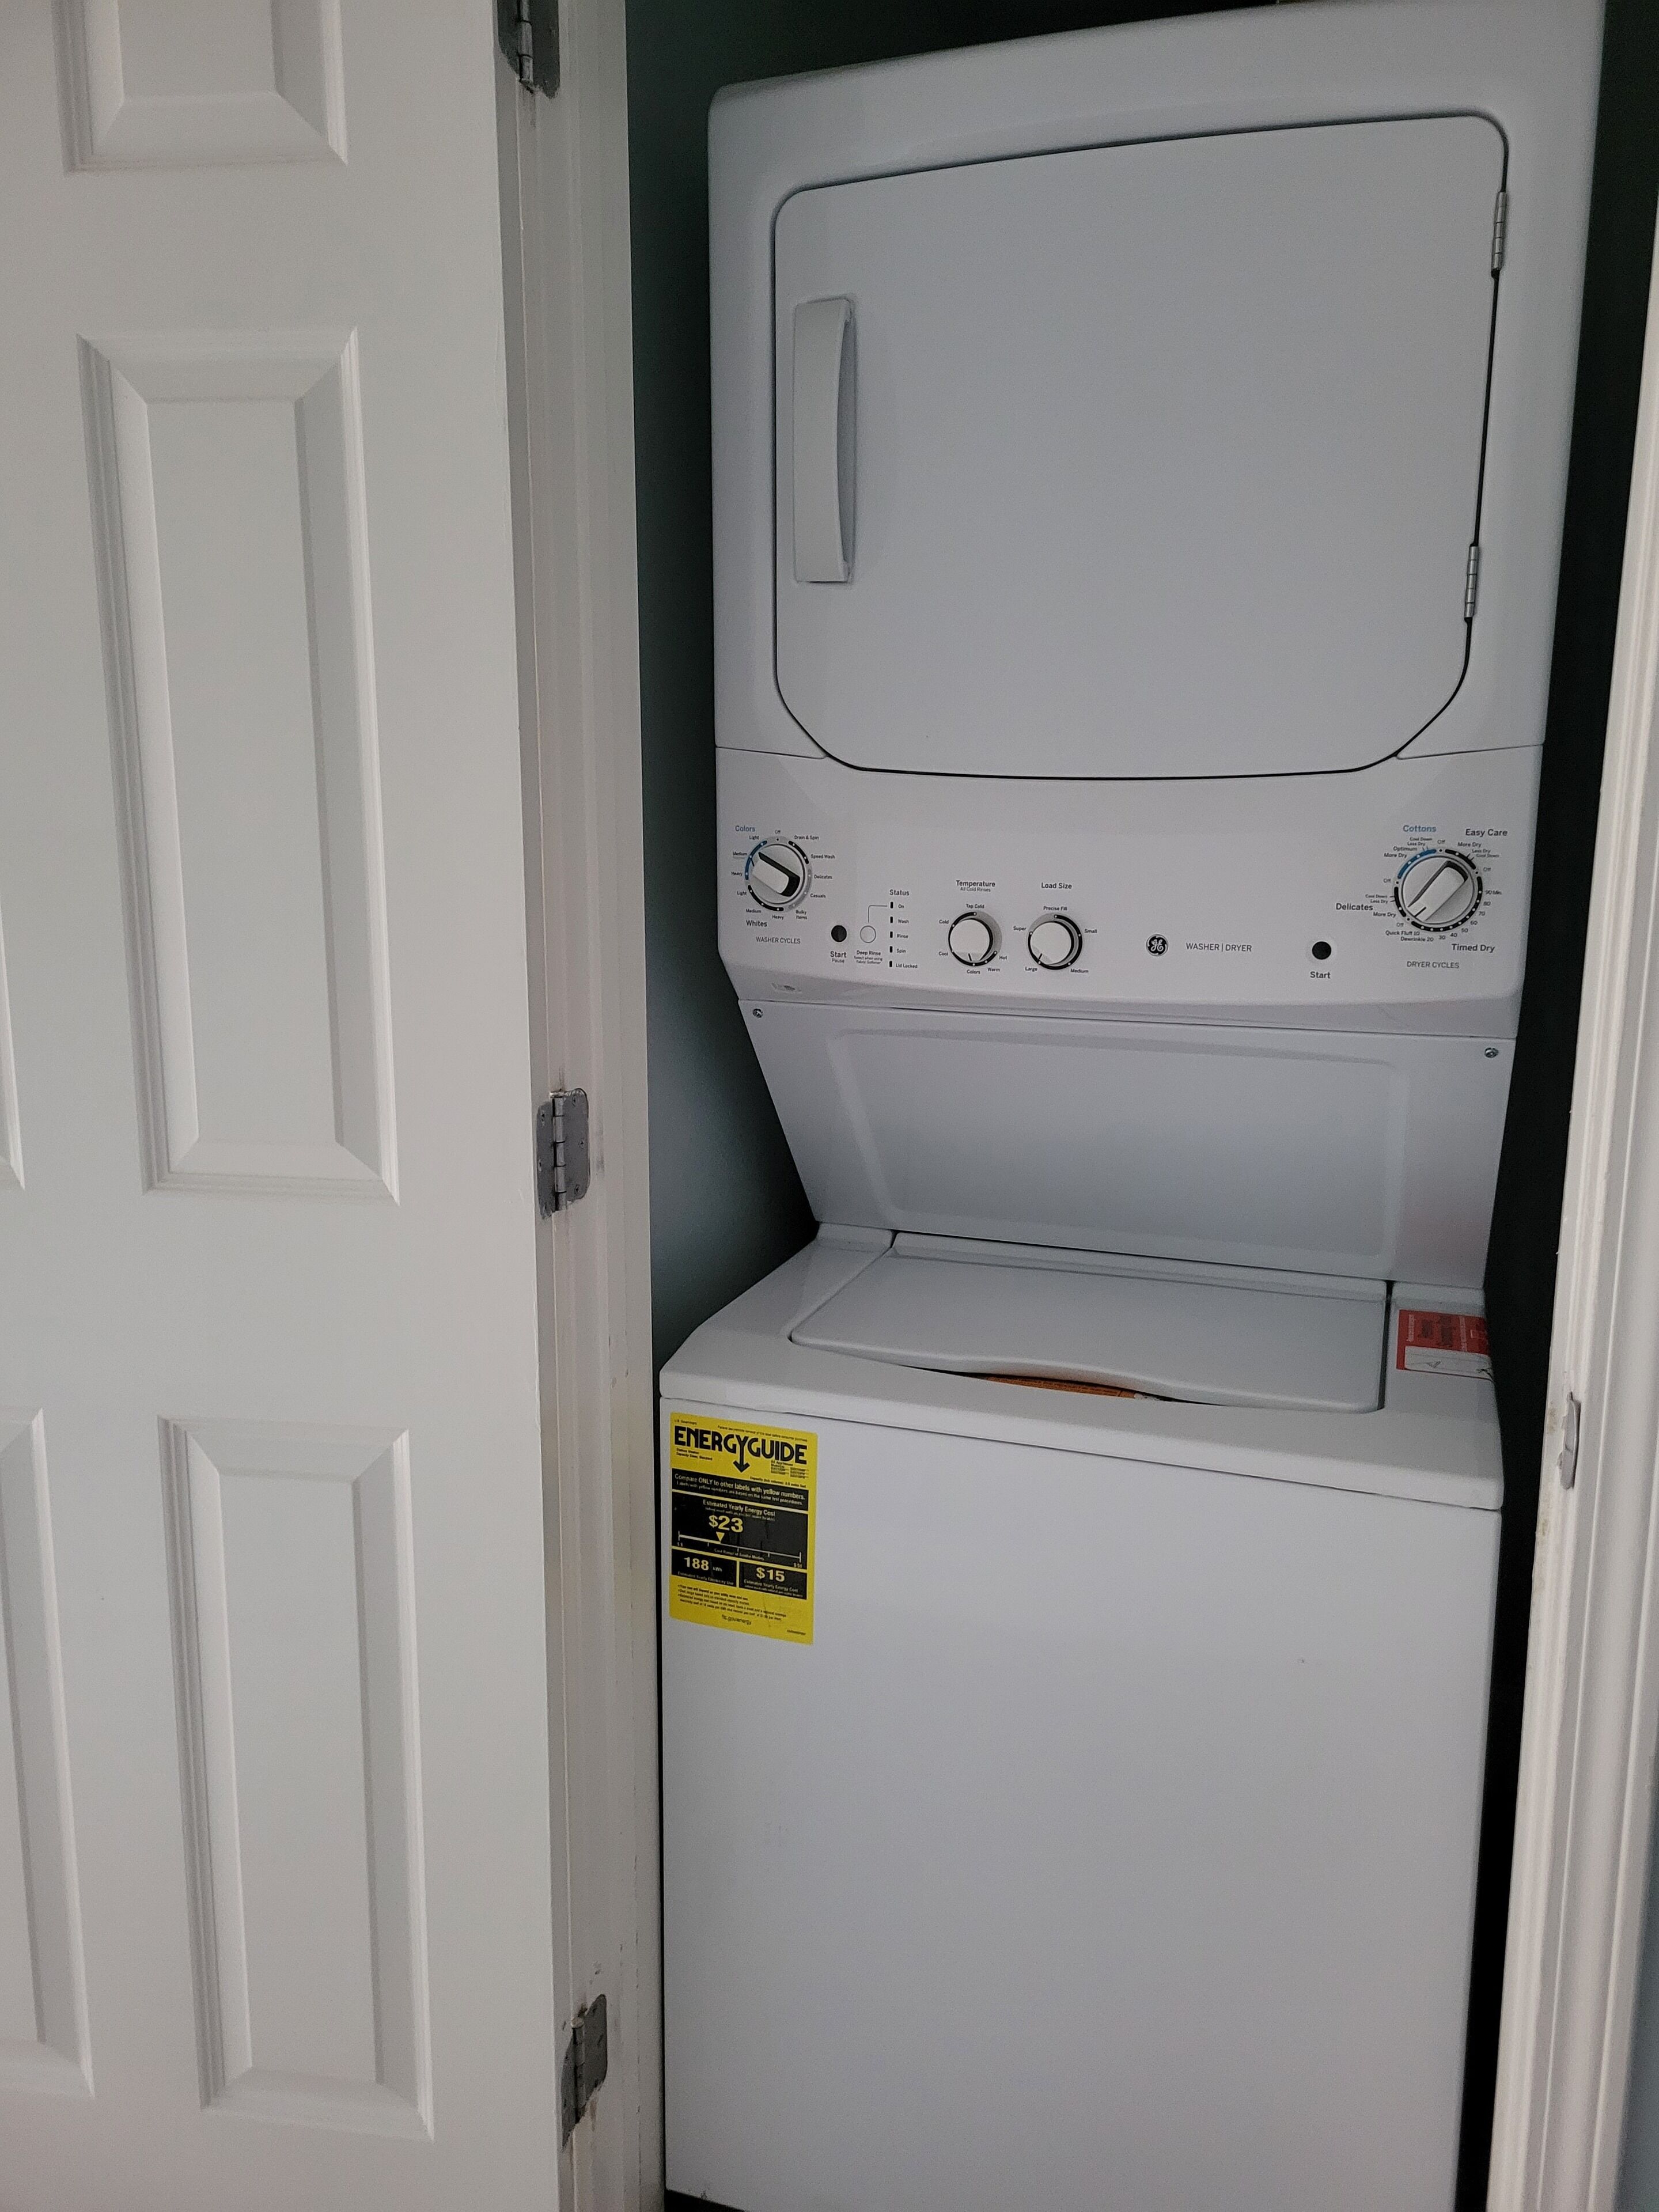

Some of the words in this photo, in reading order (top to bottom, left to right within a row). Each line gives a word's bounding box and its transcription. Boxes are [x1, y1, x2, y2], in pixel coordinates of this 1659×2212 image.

[1403, 824, 1437, 833] Cottons
[1465, 828, 1485, 838] Easy
[746, 919, 767, 927] Whites
[1225, 944, 1252, 952] DRYER
[1480, 944, 1495, 953] Dry
[675, 1425, 807, 1469] ENERGYGUIDE
[675, 1474, 698, 1483] Compare
[734, 1483, 750, 1491] labels
[781, 1492, 805, 1500] numbers.
[703, 1499, 728, 1509] Estimated
[729, 1503, 744, 1512] Yearly
[745, 1506, 762, 1516] Energy
[709, 1515, 744, 1533] $23
[684, 1556, 709, 1570] 188
[756, 1567, 785, 1582] $15
